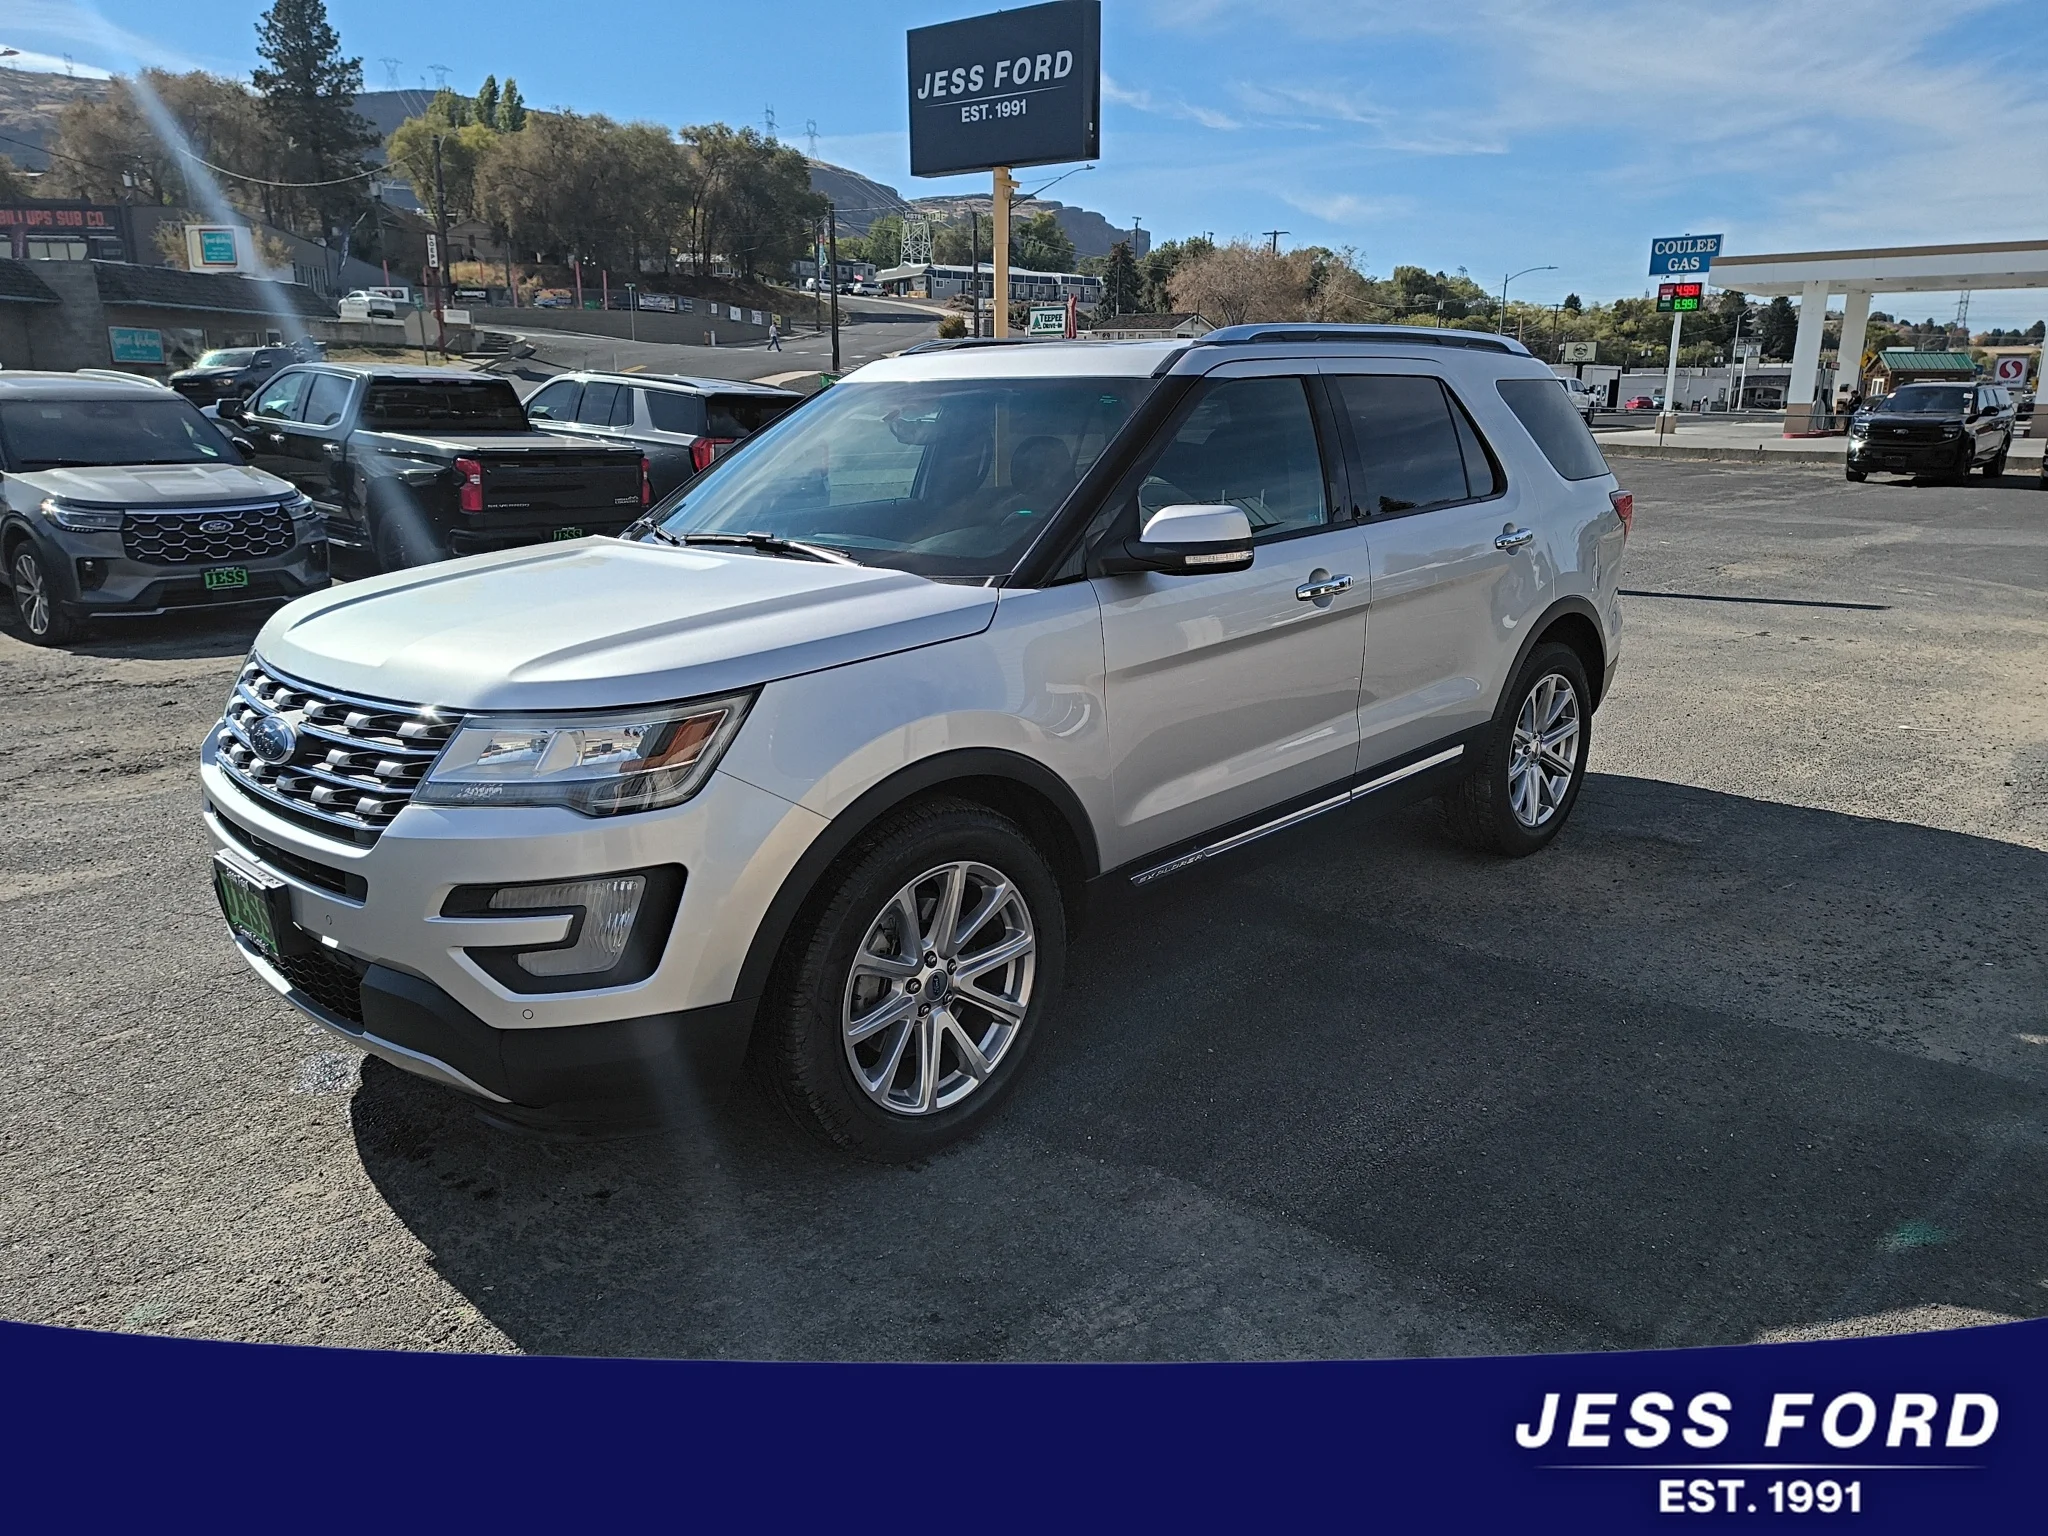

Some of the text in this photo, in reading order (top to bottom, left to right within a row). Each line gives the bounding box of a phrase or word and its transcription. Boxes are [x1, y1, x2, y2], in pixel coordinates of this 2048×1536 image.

[917, 50, 1074, 100] JESS FORD
[961, 99, 1028, 123] EST. 1991
[56, 210, 83, 226] SUB
[1654, 238, 1717, 255] COULEE
[1667, 257, 1700, 271] GAS
[1040, 314, 1062, 322] TEEPEE
[555, 530, 581, 540] JESS
[207, 570, 245, 586] JESS
